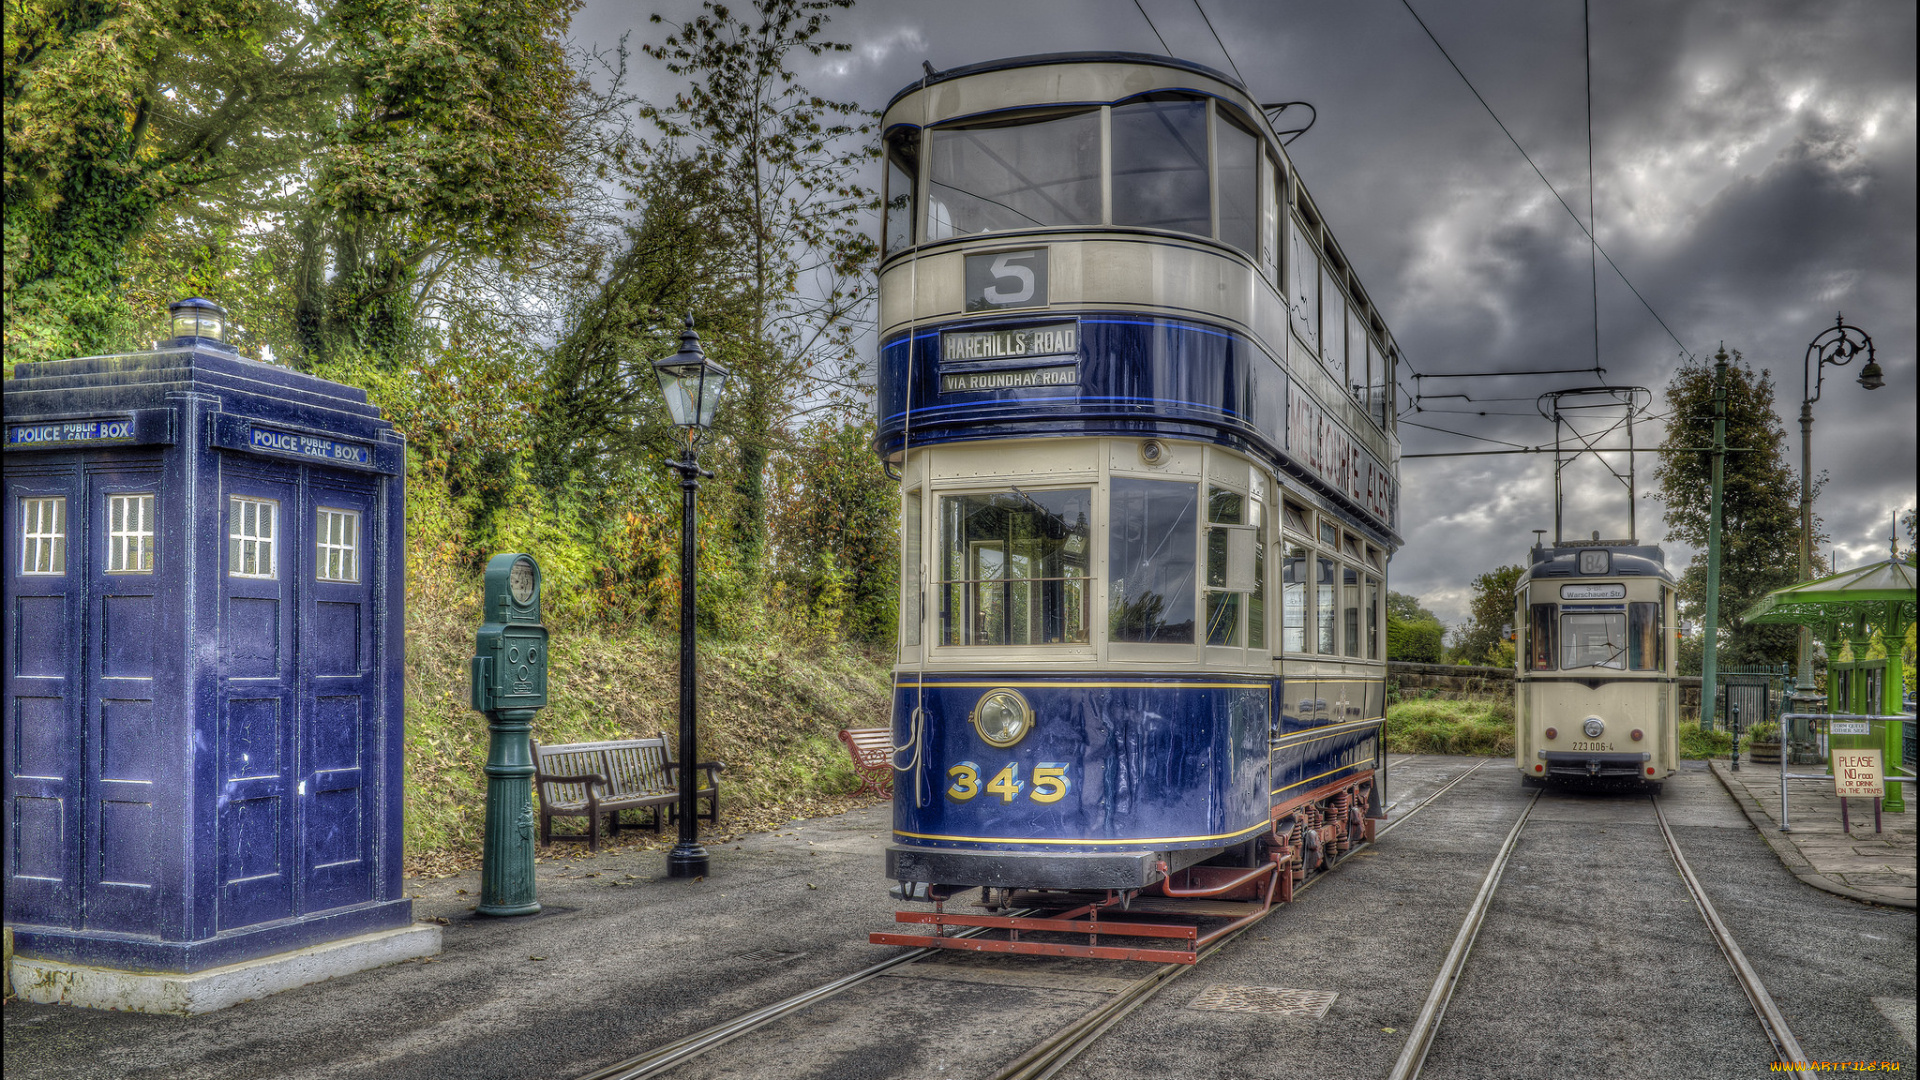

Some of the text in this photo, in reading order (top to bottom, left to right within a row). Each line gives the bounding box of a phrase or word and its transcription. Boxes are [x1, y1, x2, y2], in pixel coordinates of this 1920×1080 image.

[984, 251, 1035, 304] 5
[946, 330, 1075, 360] HAREHILLS ROAD
[947, 371, 1076, 389] VIA ROUNDHAY ROAD
[17, 422, 129, 443] POLICE PUBLIC CALL BOX
[254, 430, 360, 461] POLICE PUBLIC CALL BOX
[1367, 463, 1388, 521] ALES
[1586, 555, 1602, 571] 84
[1573, 742, 1614, 751] 223 006-4
[1839, 757, 1874, 767] PLEASE
[945, 761, 1072, 806] 345
[1845, 769, 1856, 779] NO
